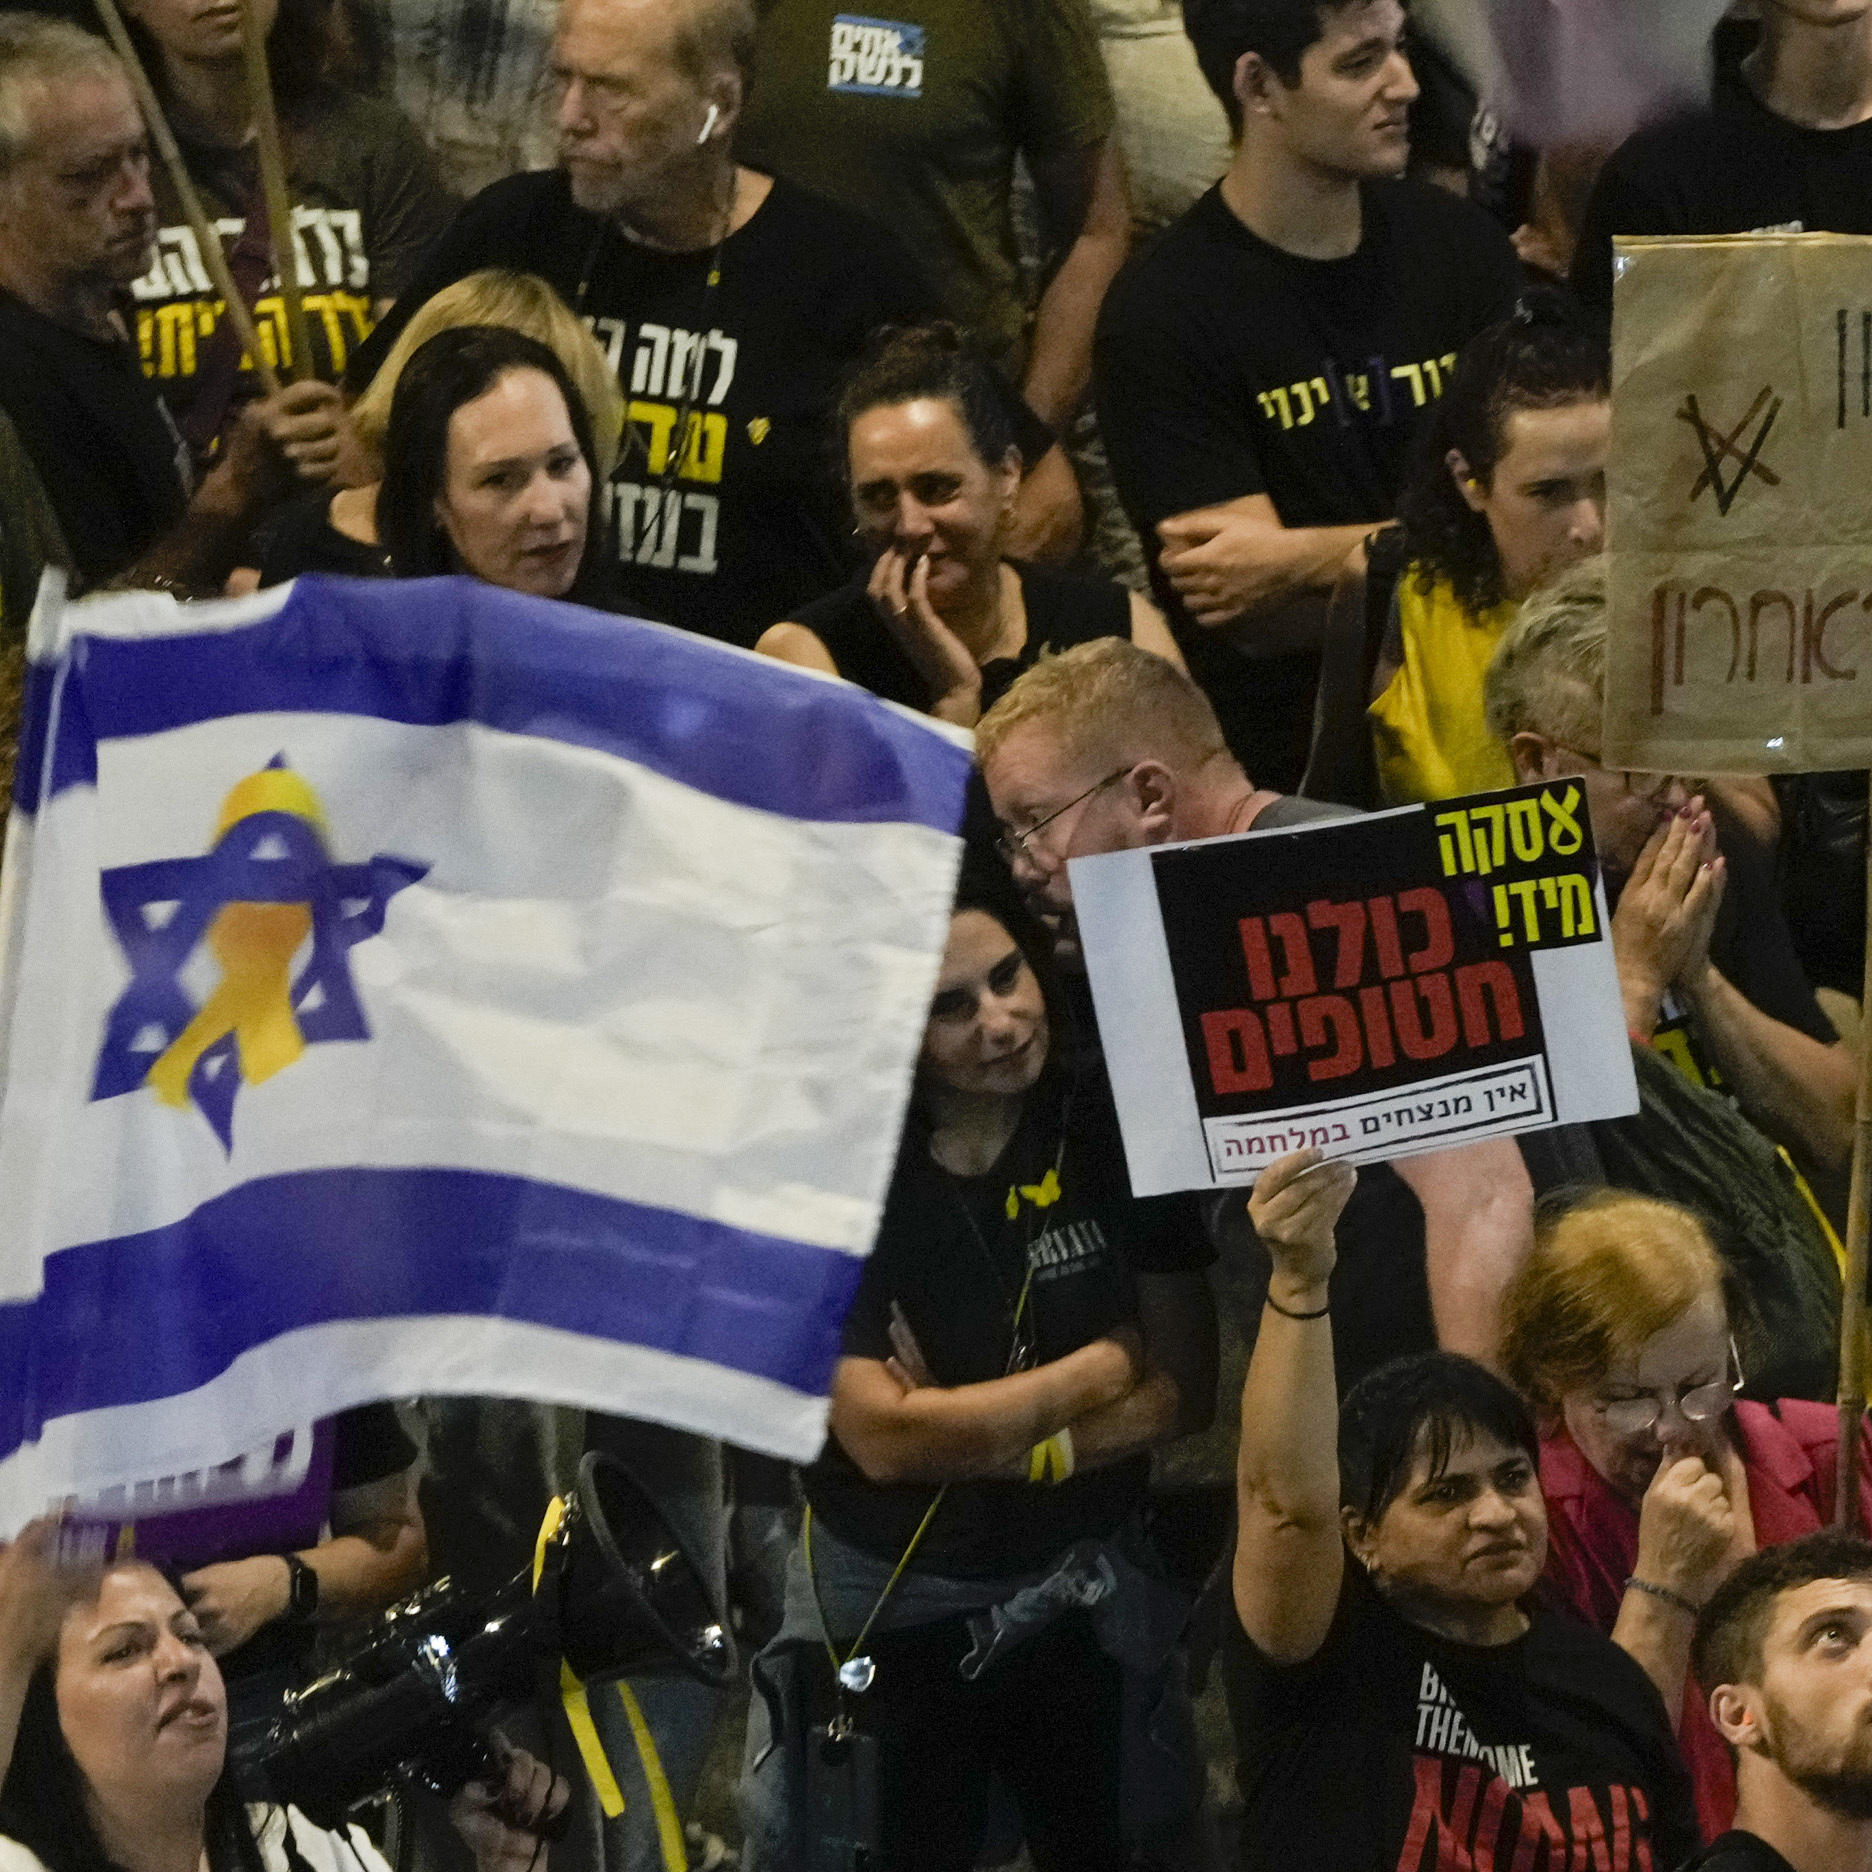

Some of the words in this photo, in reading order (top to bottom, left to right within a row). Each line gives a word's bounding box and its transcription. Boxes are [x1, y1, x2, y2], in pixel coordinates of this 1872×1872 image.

[631, 325, 738, 405] למה
[1434, 784, 1583, 878] עסקה
[1238, 886, 1456, 1002] כולנו
[1491, 872, 1597, 948] מיד!
[1200, 959, 1526, 1095] חטופים
[1359, 1092, 1473, 1137] מנצחים
[1482, 1078, 1529, 1116] אין
[1224, 1120, 1352, 1160] במלחמה
